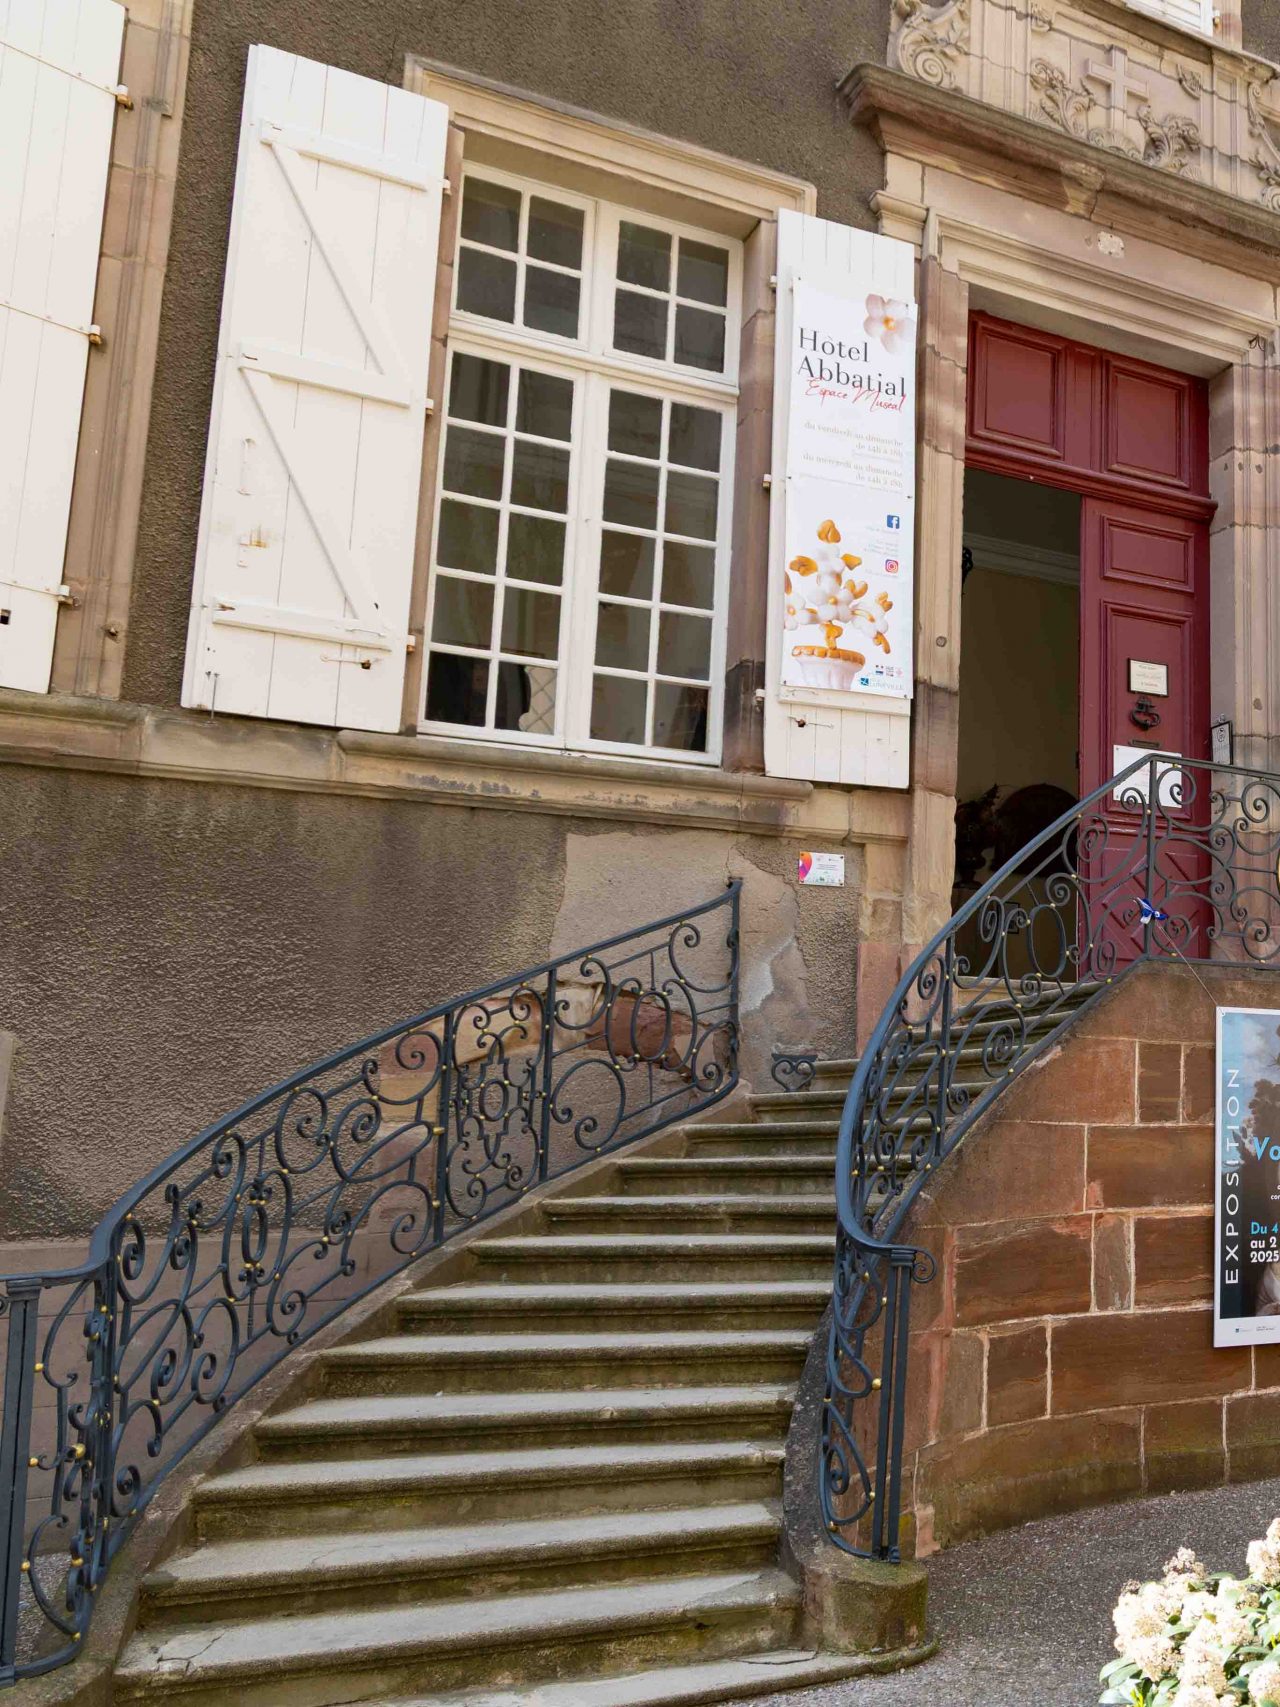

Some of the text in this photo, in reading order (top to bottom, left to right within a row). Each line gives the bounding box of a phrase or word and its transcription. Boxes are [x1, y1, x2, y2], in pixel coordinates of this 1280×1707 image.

[797, 355, 905, 398] Abbatial
[805, 376, 907, 414] Espace Muséal
[1225, 1068, 1240, 1285] EXPOSITION
[1250, 1221, 1268, 1235] Du
[1271, 1222, 1279, 1234] 4
[1250, 1239, 1266, 1249] au
[1269, 1236, 1278, 1248] 2
[1250, 1250, 1280, 1264] 2025
